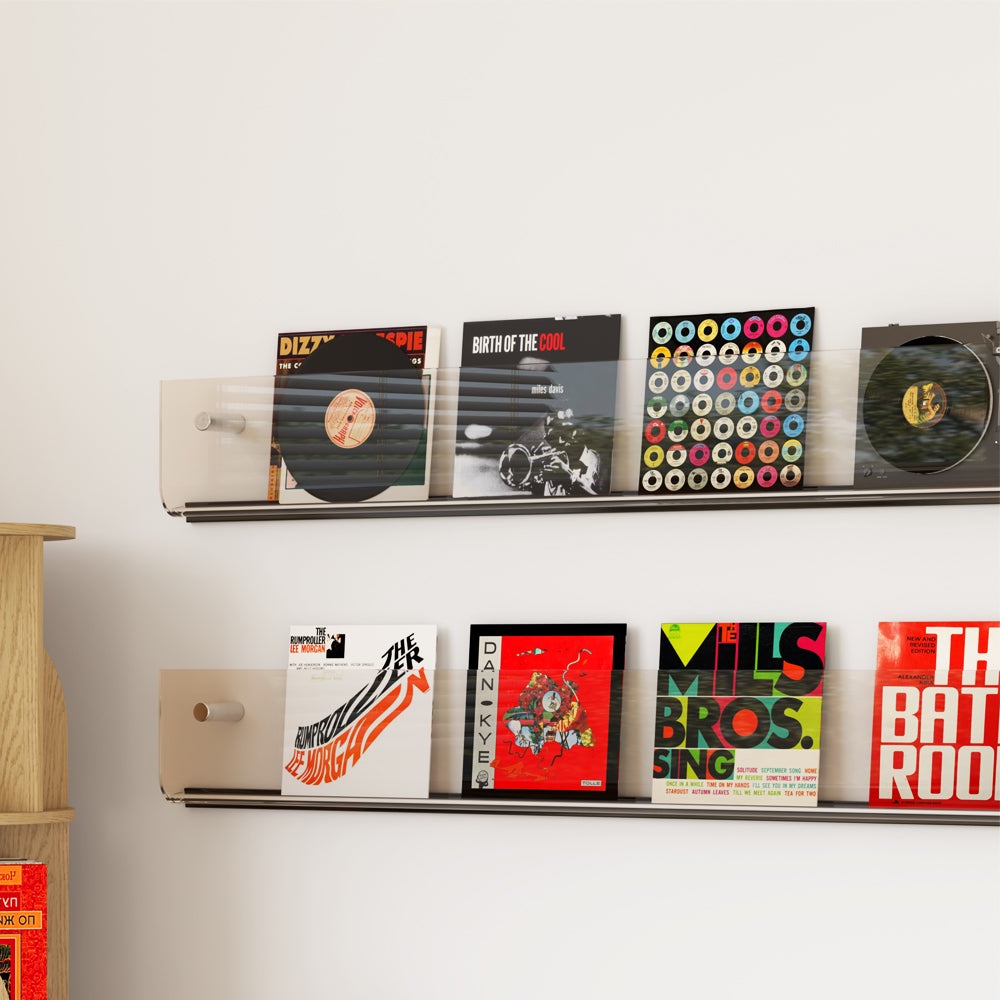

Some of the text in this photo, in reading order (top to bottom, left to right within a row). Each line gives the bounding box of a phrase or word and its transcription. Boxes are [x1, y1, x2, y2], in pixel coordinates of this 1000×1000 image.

[472, 332, 566, 354] BIRTH OF THE COOL
[531, 384, 564, 394] miles davis
[290, 636, 326, 644] RUMPROLLER
[316, 627, 326, 636] THE
[290, 644, 325, 653] LEE MORGAN
[381, 633, 418, 670] THE
[285, 667, 430, 785] LEE MORGAN
[654, 697, 813, 749] BROS.
[881, 686, 1000, 744] BAT
[653, 749, 735, 780] SING
[878, 744, 1000, 801] ROO
